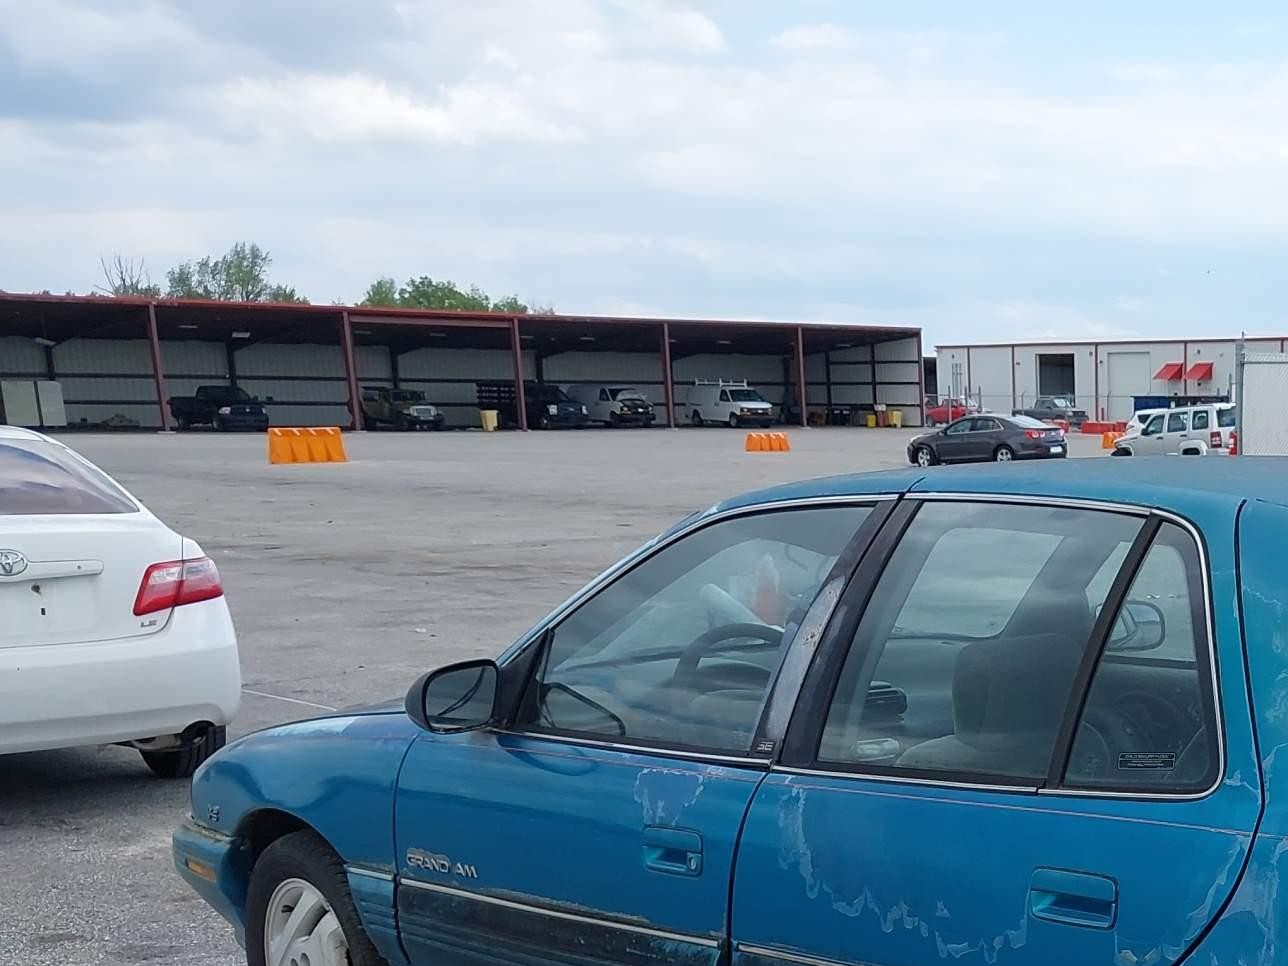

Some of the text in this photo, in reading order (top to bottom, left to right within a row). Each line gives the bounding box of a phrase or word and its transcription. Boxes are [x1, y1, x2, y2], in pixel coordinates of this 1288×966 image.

[140, 619, 157, 628] LE
[407, 853, 478, 879] GRAND AM
